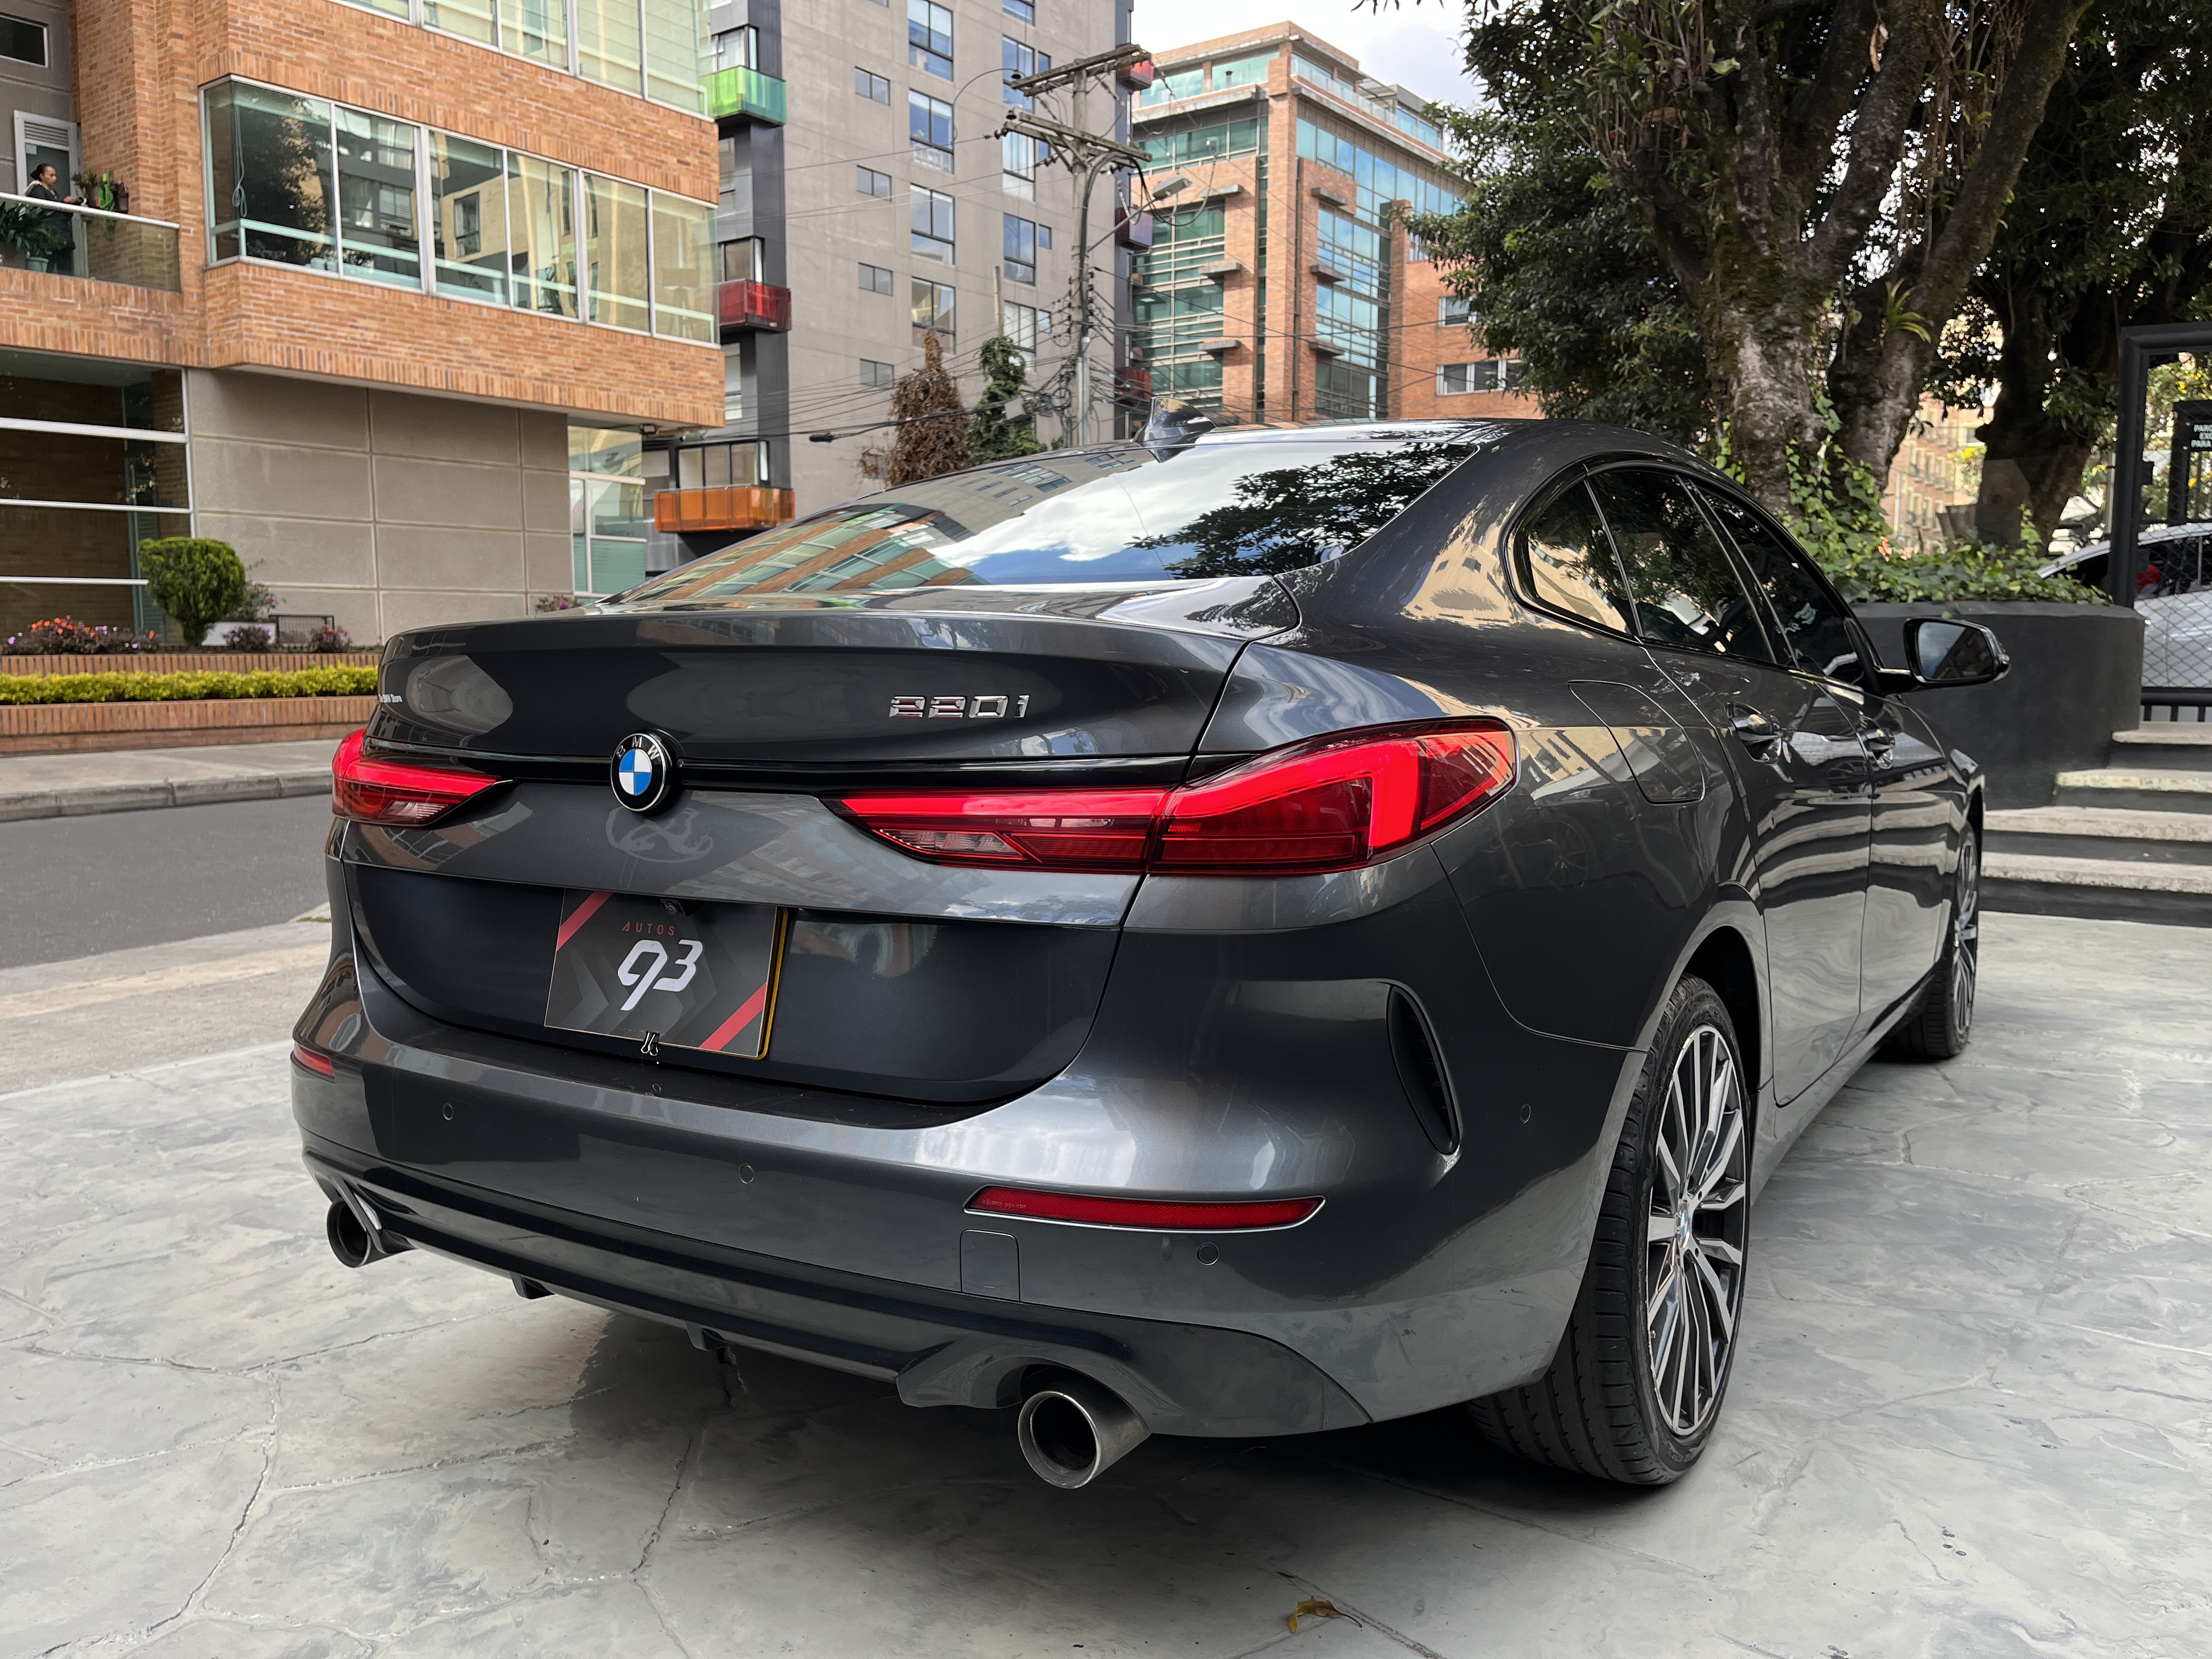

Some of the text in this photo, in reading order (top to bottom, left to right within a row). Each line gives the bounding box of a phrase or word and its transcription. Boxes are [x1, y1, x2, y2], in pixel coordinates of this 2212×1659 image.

[889, 695, 1030, 719] 220i
[616, 736, 660, 760] BMW
[622, 921, 675, 936] AUTOS
[617, 939, 703, 1011] 93
